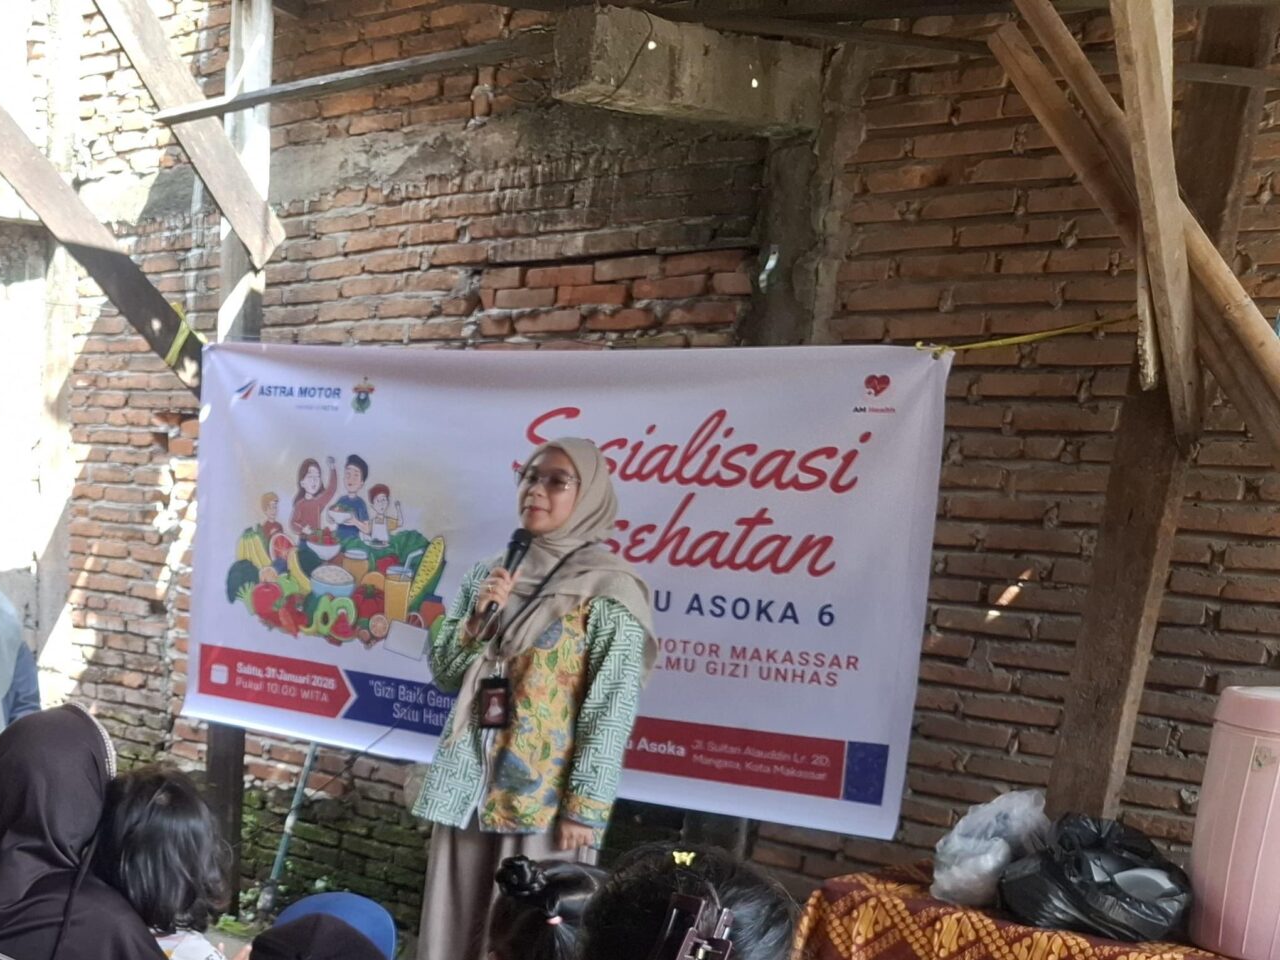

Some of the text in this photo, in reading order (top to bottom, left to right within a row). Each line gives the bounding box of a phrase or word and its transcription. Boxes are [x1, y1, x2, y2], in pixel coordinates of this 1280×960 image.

[258, 385, 341, 399] ASTRA MOTOR
[513, 406, 873, 494] Ssialisasi
[603, 492, 836, 577] sehatan
[685, 593, 800, 625] ASOKA
[818, 603, 835, 627] 6
[730, 646, 859, 671] MAKASSAR
[705, 660, 749, 679] GIZI
[758, 665, 839, 688] UNHAS
[300, 688, 329, 704] WITA
[398, 685, 423, 705] Baik
[392, 702, 419, 722] Satu
[636, 737, 687, 757] Asoka
[706, 741, 741, 755] Sultan
[744, 761, 771, 774] Kota
[773, 764, 827, 781] Makassar
